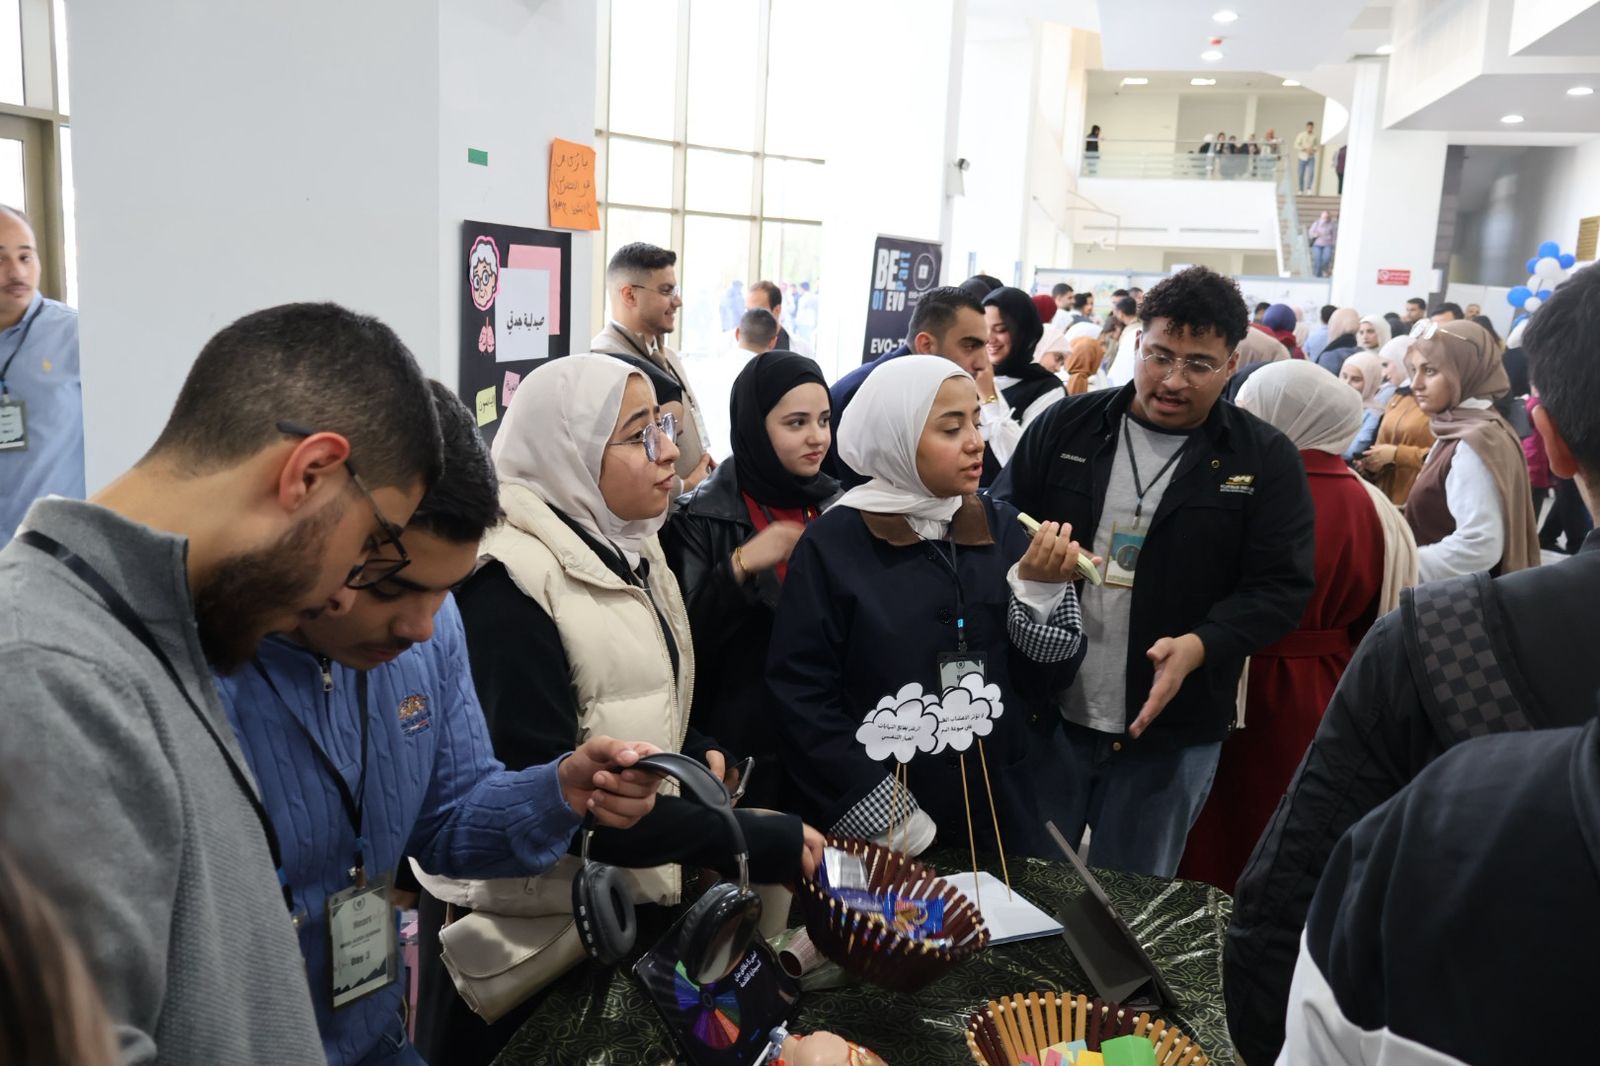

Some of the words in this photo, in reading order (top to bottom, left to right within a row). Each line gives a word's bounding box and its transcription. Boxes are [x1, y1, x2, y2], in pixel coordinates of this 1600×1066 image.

[874, 249, 900, 290] BE
[885, 292, 906, 312] EVO
[506, 310, 523, 335] جدتي
[524, 312, 545, 331] صيدلية
[870, 338, 906, 354] EVO-T
